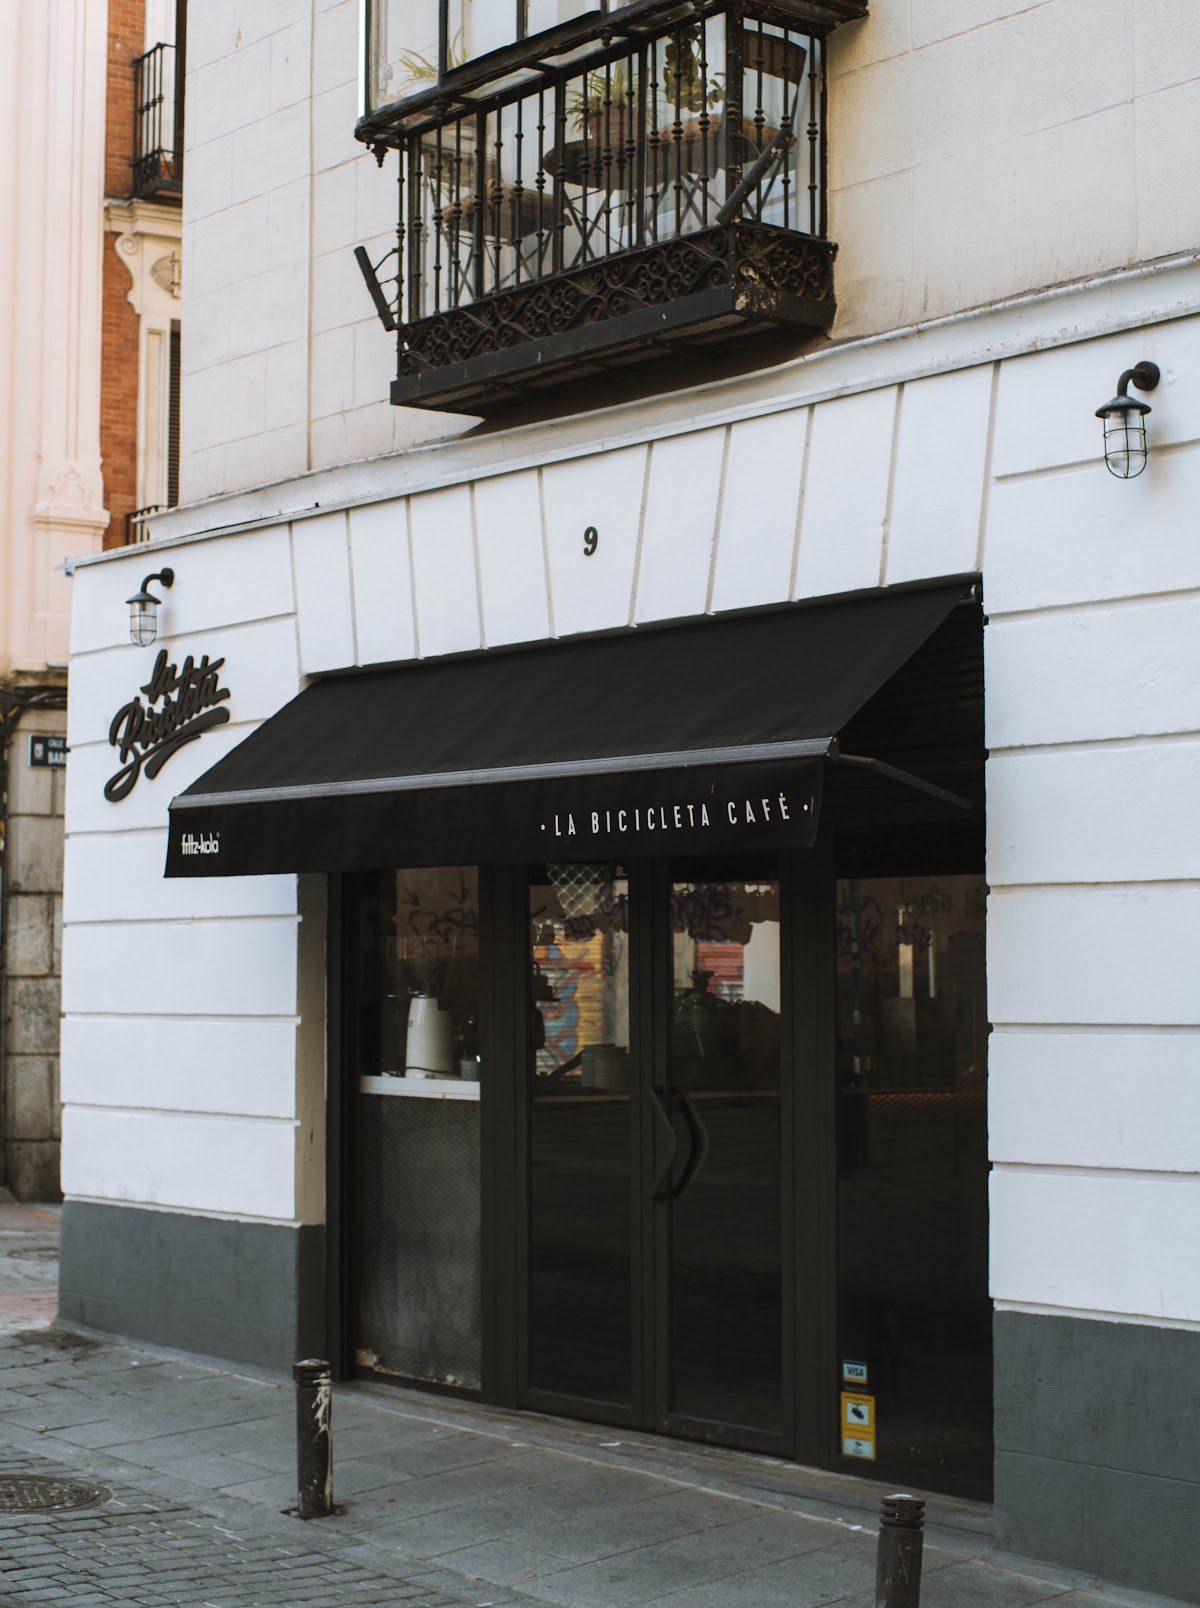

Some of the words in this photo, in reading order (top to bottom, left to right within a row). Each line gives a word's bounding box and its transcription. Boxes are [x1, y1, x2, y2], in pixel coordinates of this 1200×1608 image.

[584, 526, 599, 556] 9
[554, 814, 577, 837] LA
[591, 803, 710, 834] BICICLETA
[846, 1366, 865, 1377] VISA
